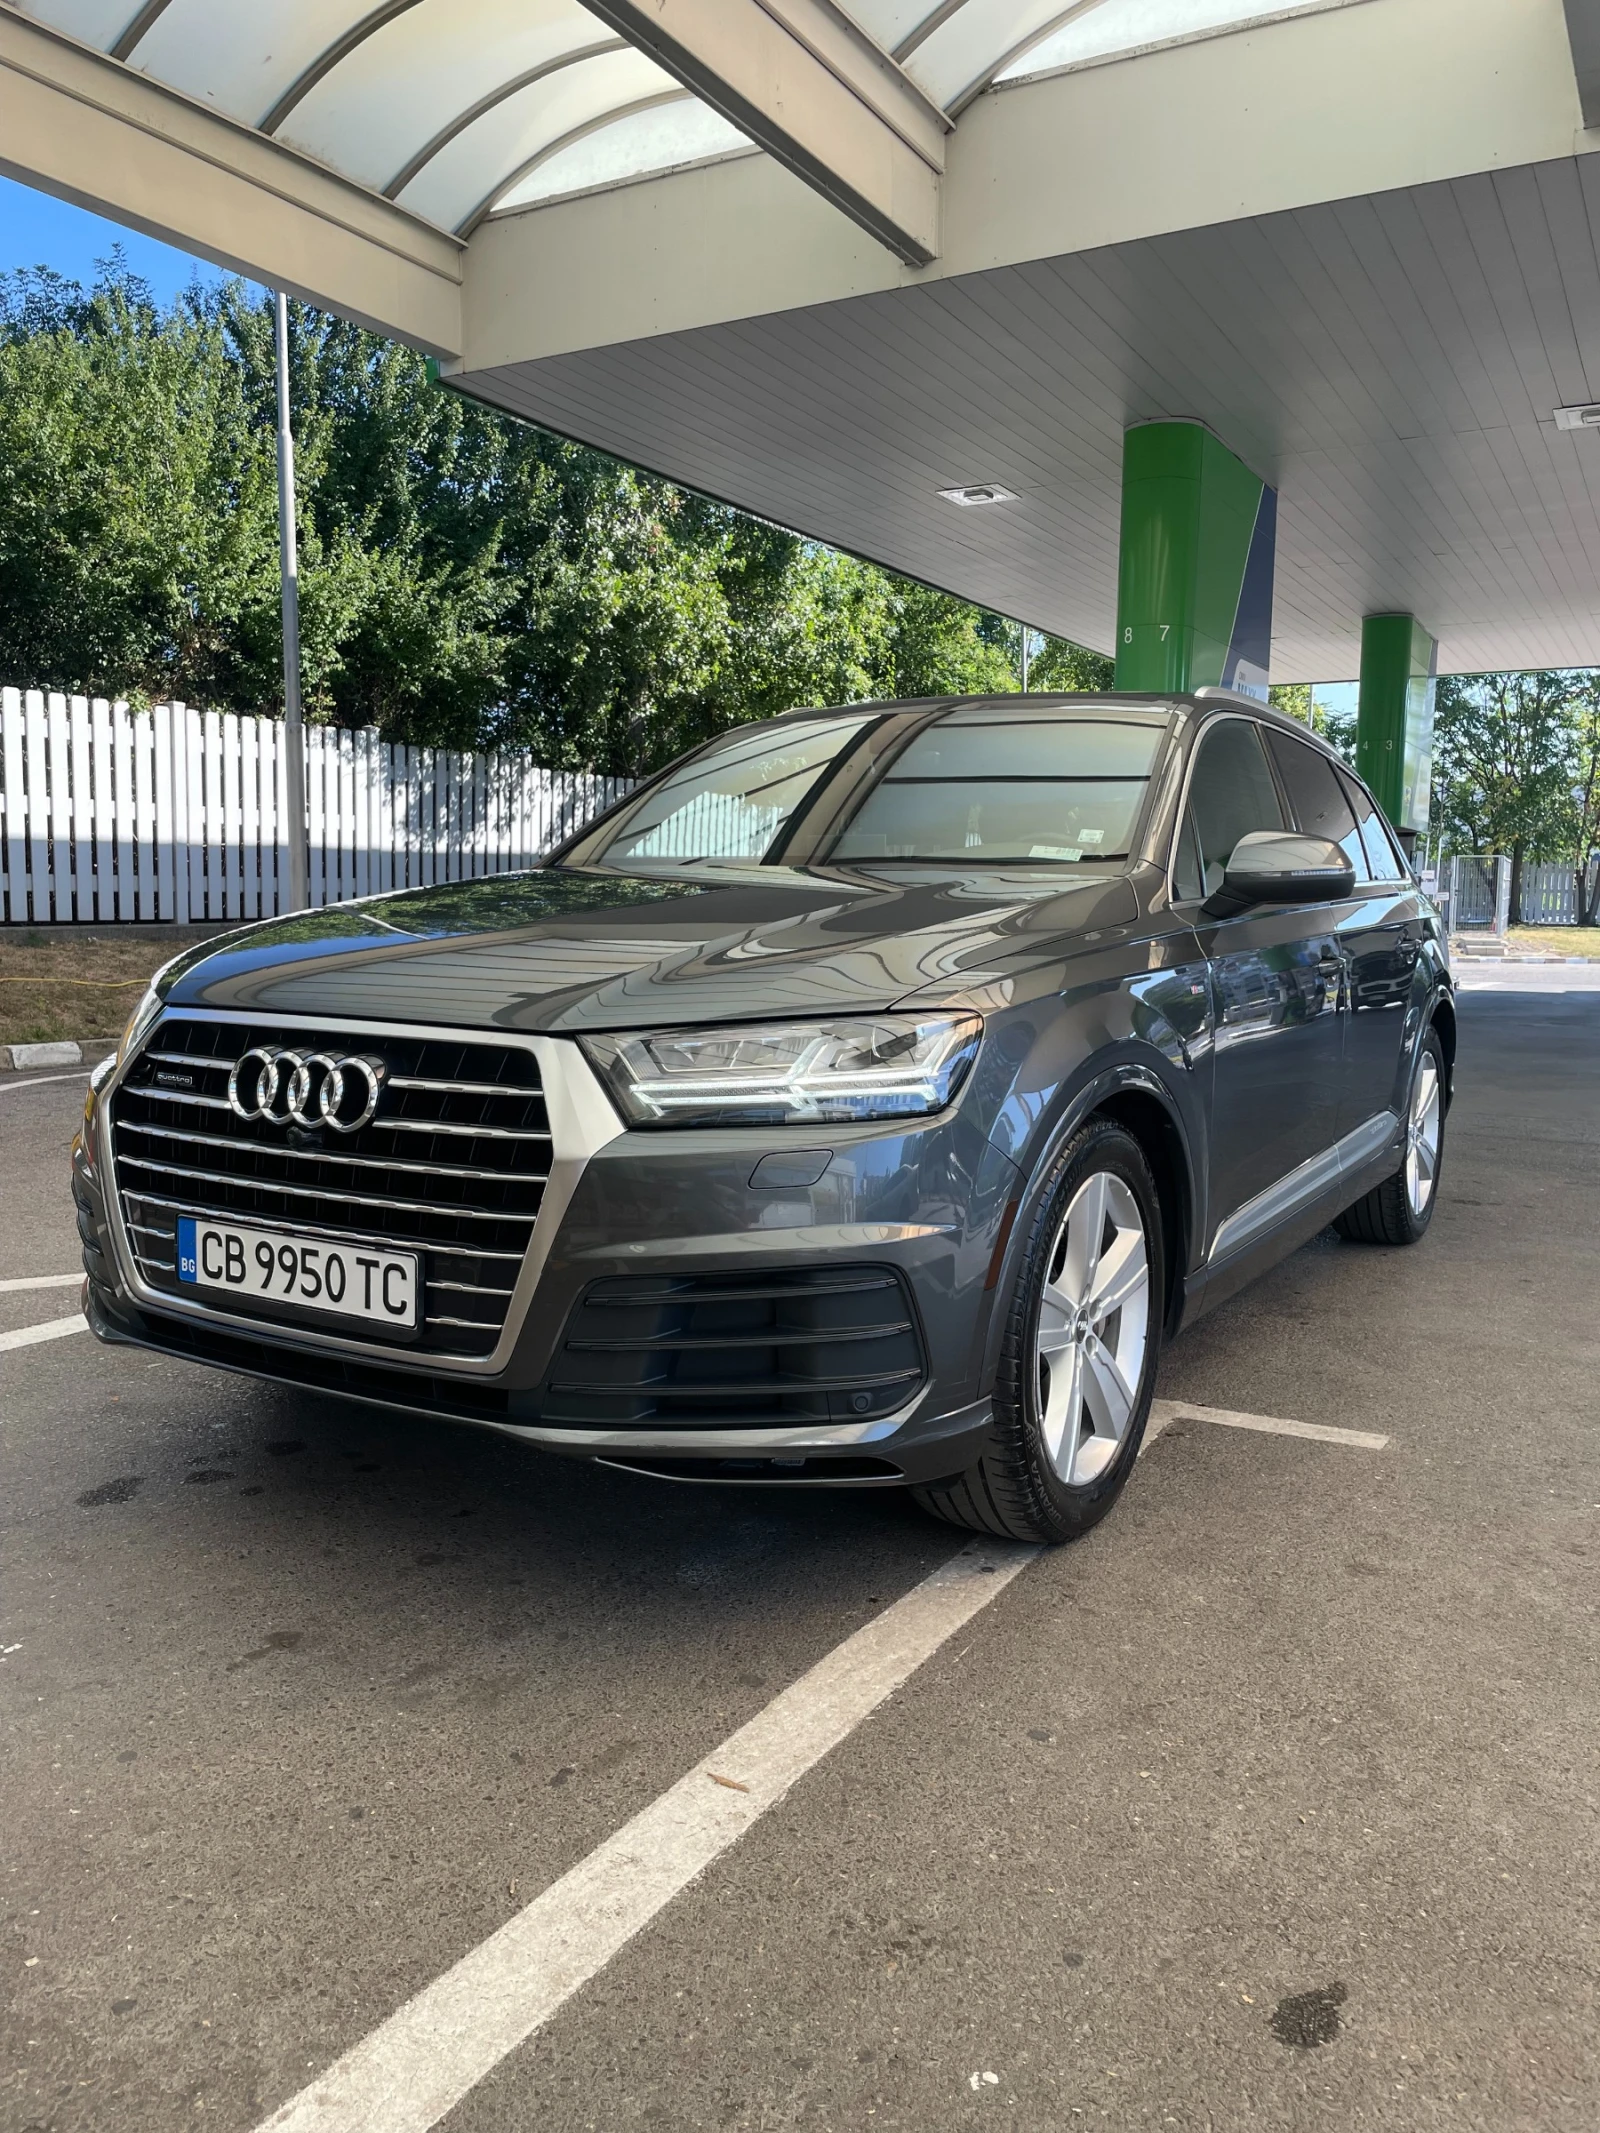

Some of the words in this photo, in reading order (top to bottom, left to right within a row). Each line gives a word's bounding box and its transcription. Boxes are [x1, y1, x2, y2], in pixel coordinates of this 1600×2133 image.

[1124, 627, 1132, 643] 8
[1160, 625, 1170, 641] 7
[1362, 741, 1369, 751] 4
[1386, 740, 1392, 750] 3
[181, 1257, 195, 1273] BG
[202, 1231, 246, 1283] CB
[255, 1240, 346, 1302] 9950
[356, 1257, 407, 1315] TC
